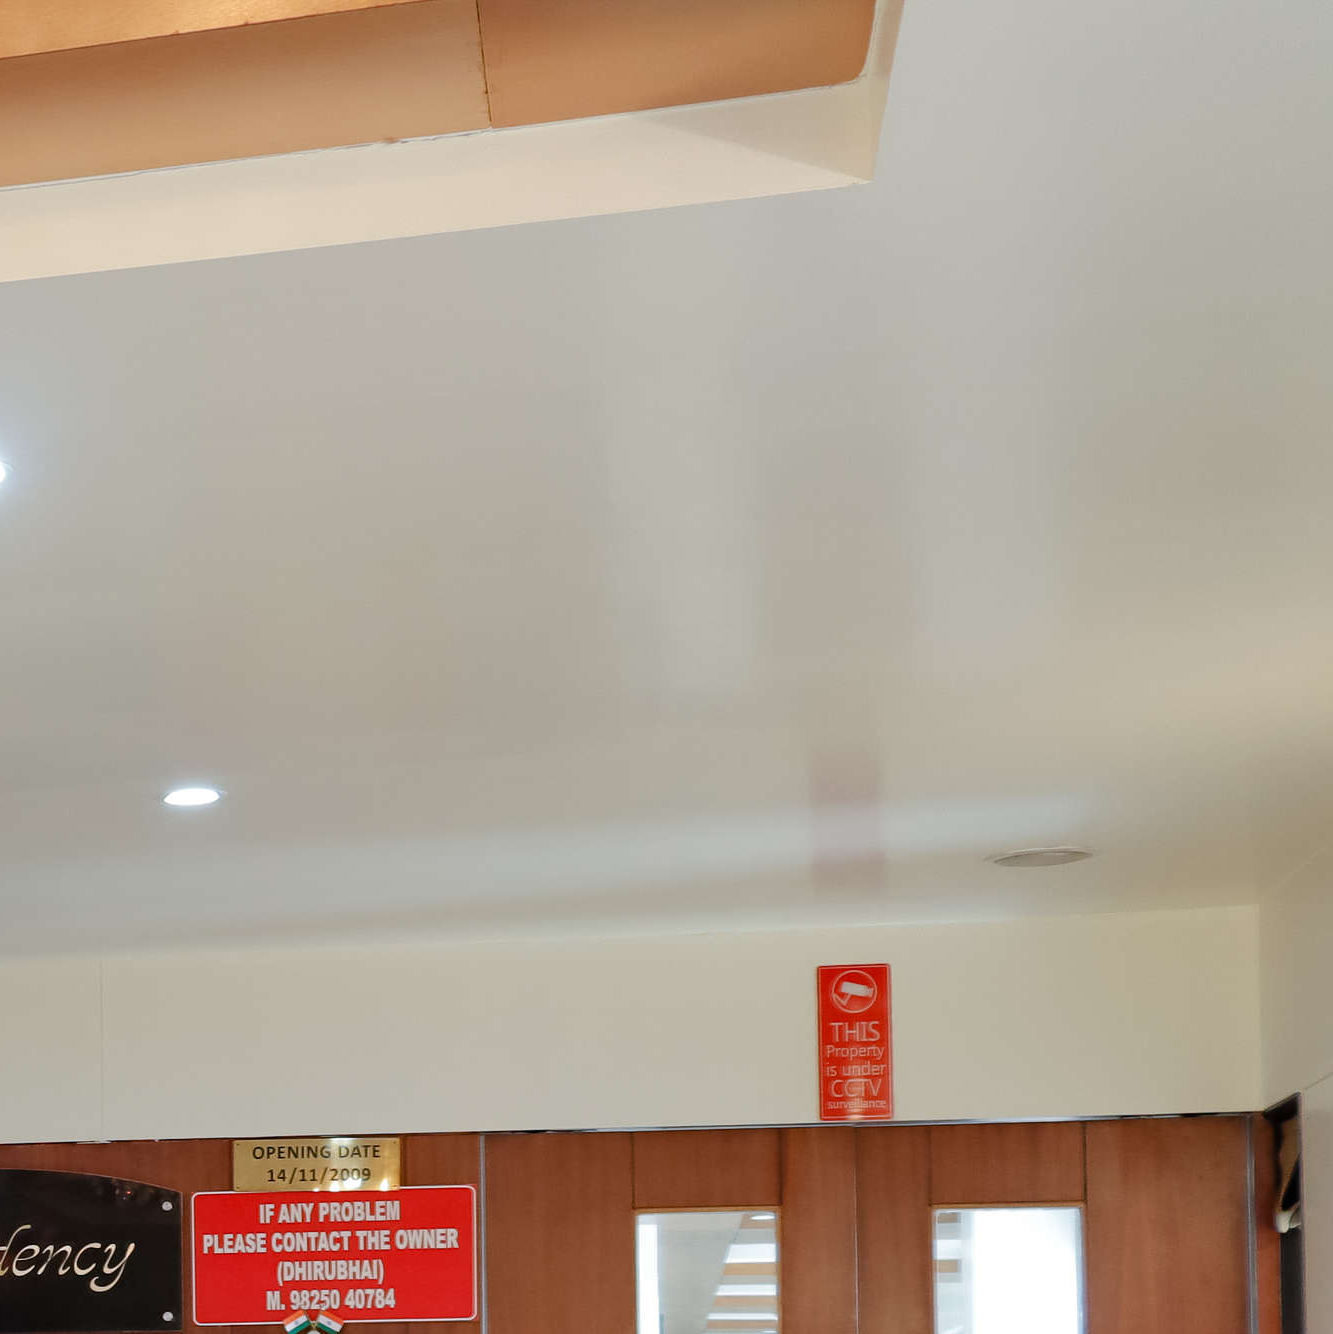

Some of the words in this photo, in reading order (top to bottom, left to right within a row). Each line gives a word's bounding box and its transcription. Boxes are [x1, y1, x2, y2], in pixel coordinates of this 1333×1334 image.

[830, 1021, 881, 1042] THIS
[827, 1045, 885, 1060] Property
[827, 1062, 837, 1076] is
[842, 1062, 885, 1076] under
[831, 1078, 882, 1097] CCTV
[828, 1099, 886, 1109] surveillance
[252, 1145, 331, 1160] OPENING
[338, 1144, 381, 1158] DATE
[267, 1167, 371, 1185] 14/11/2009
[259, 1203, 275, 1224] IF
[278, 1203, 314, 1223] ANY
[319, 1200, 401, 1221] PROBLEM
[202, 1232, 267, 1254] PLEASE
[271, 1231, 351, 1252] CONTACT
[356, 1229, 390, 1250] THE
[395, 1228, 459, 1249] OWNER
[277, 1259, 384, 1286] (DHIRUBHAI)
[266, 1290, 285, 1311] M.
[290, 1288, 340, 1310] 98250
[344, 1287, 396, 1309] 40784
